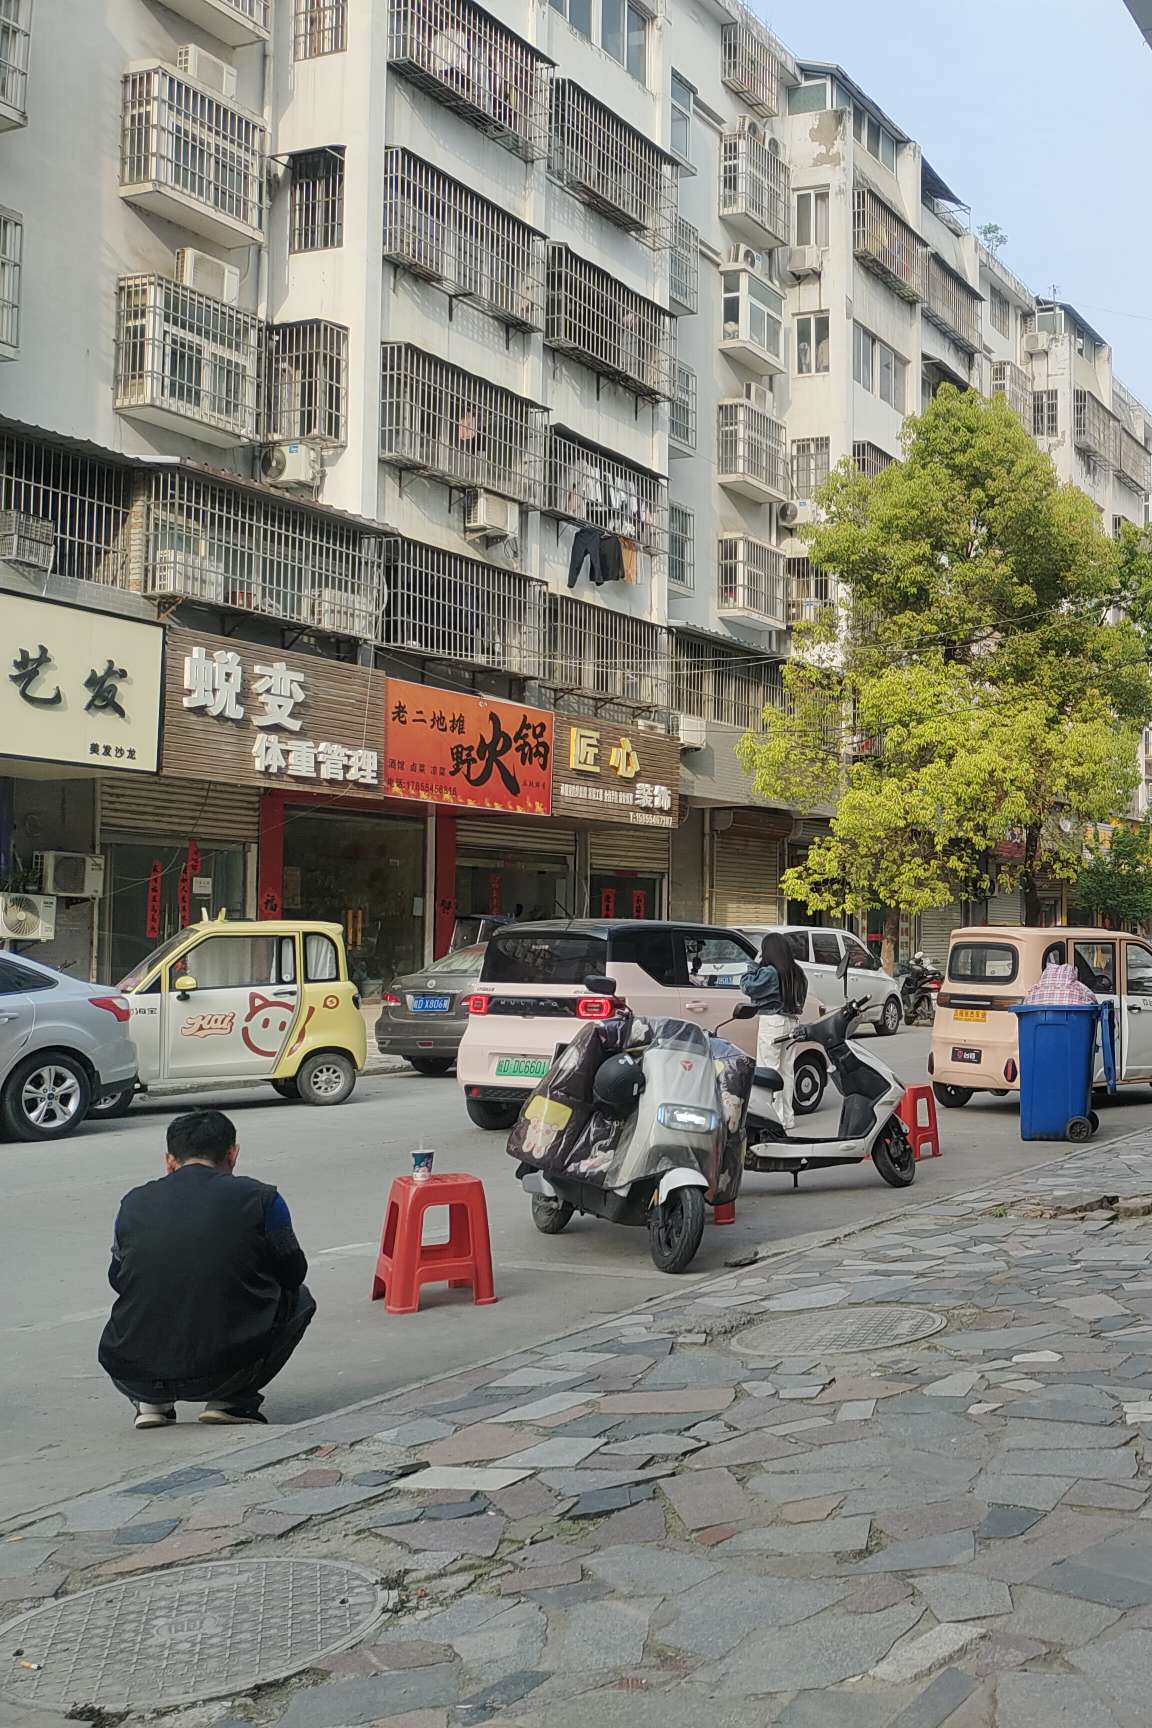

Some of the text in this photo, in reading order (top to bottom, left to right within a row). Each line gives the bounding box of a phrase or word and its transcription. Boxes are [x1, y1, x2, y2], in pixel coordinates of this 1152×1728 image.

[183, 646, 306, 731] 蜕变
[391, 700, 466, 735] 老二地摊
[89, 743, 137, 760] 美发沙龙
[252, 733, 379, 784] 体重管理
[569, 727, 641, 778] 匠心
[634, 782, 672, 810] 装饰
